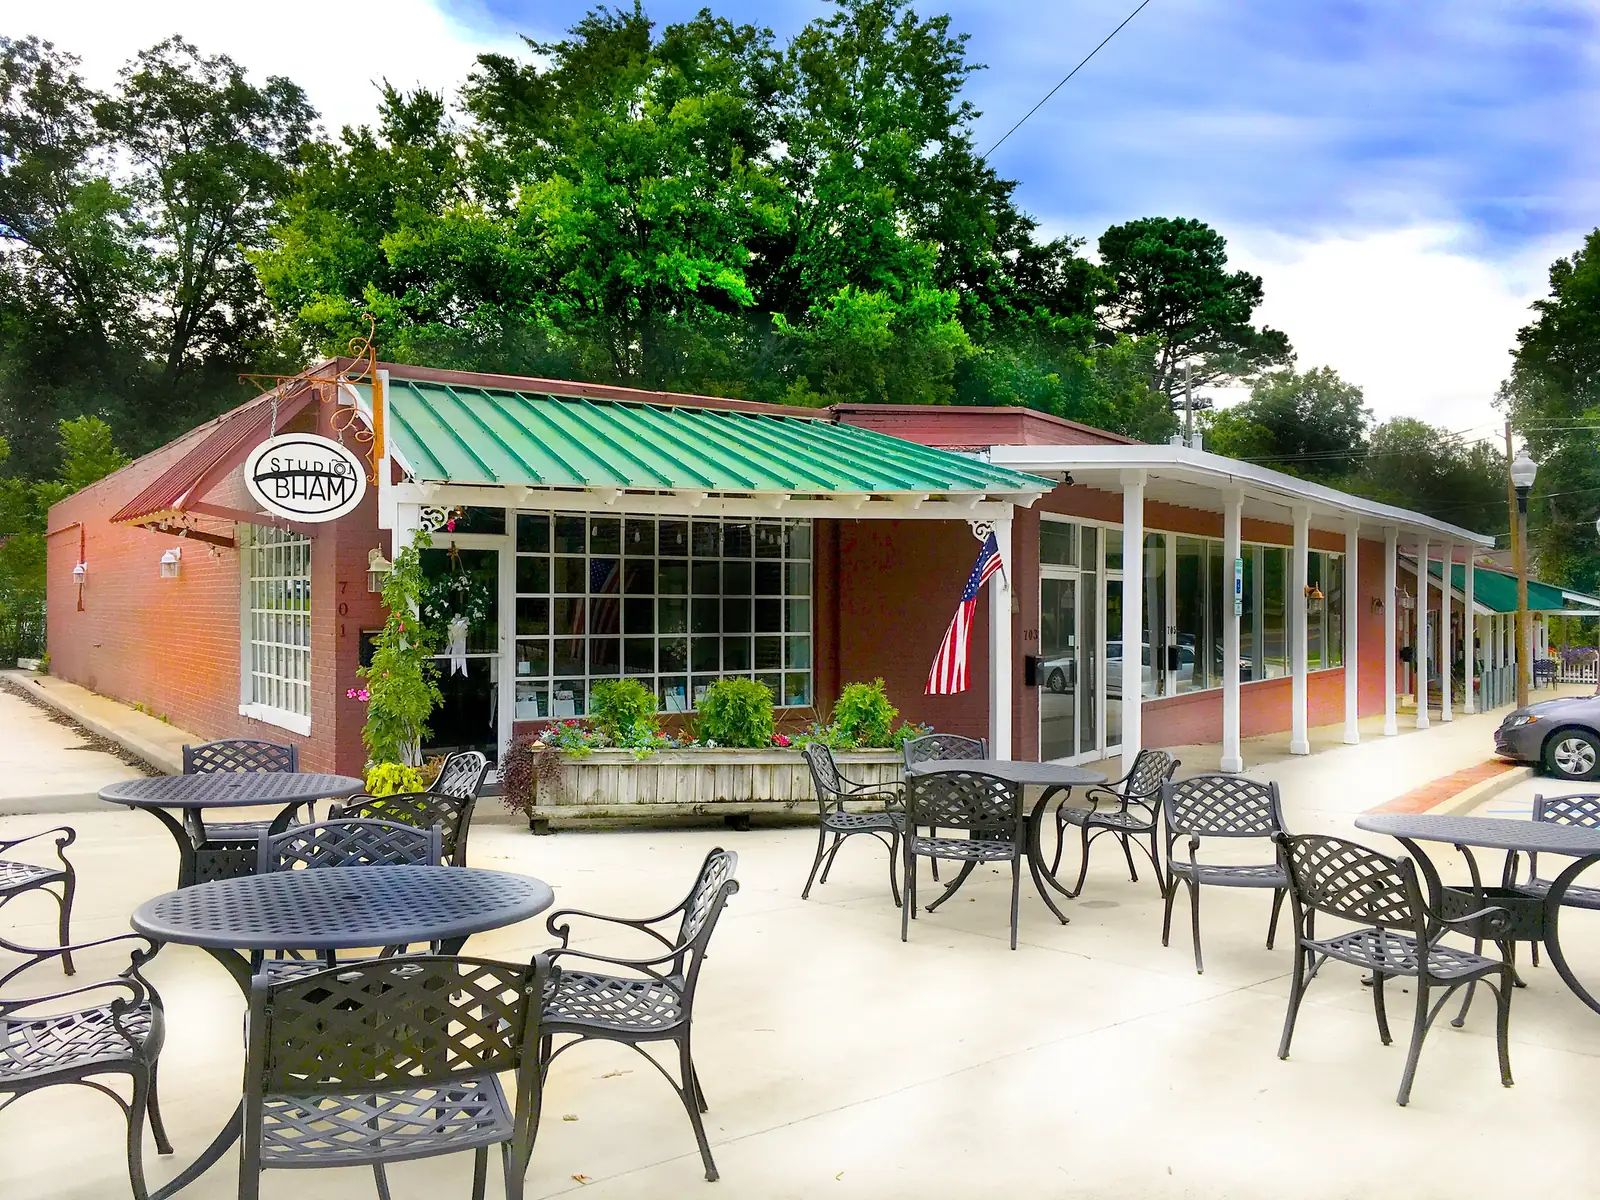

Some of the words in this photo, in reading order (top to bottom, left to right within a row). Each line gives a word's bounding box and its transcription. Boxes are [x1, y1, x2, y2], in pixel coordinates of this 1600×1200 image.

[270, 457, 347, 475] STUDIO
[275, 477, 345, 503] BHAM
[338, 581, 348, 637] 701
